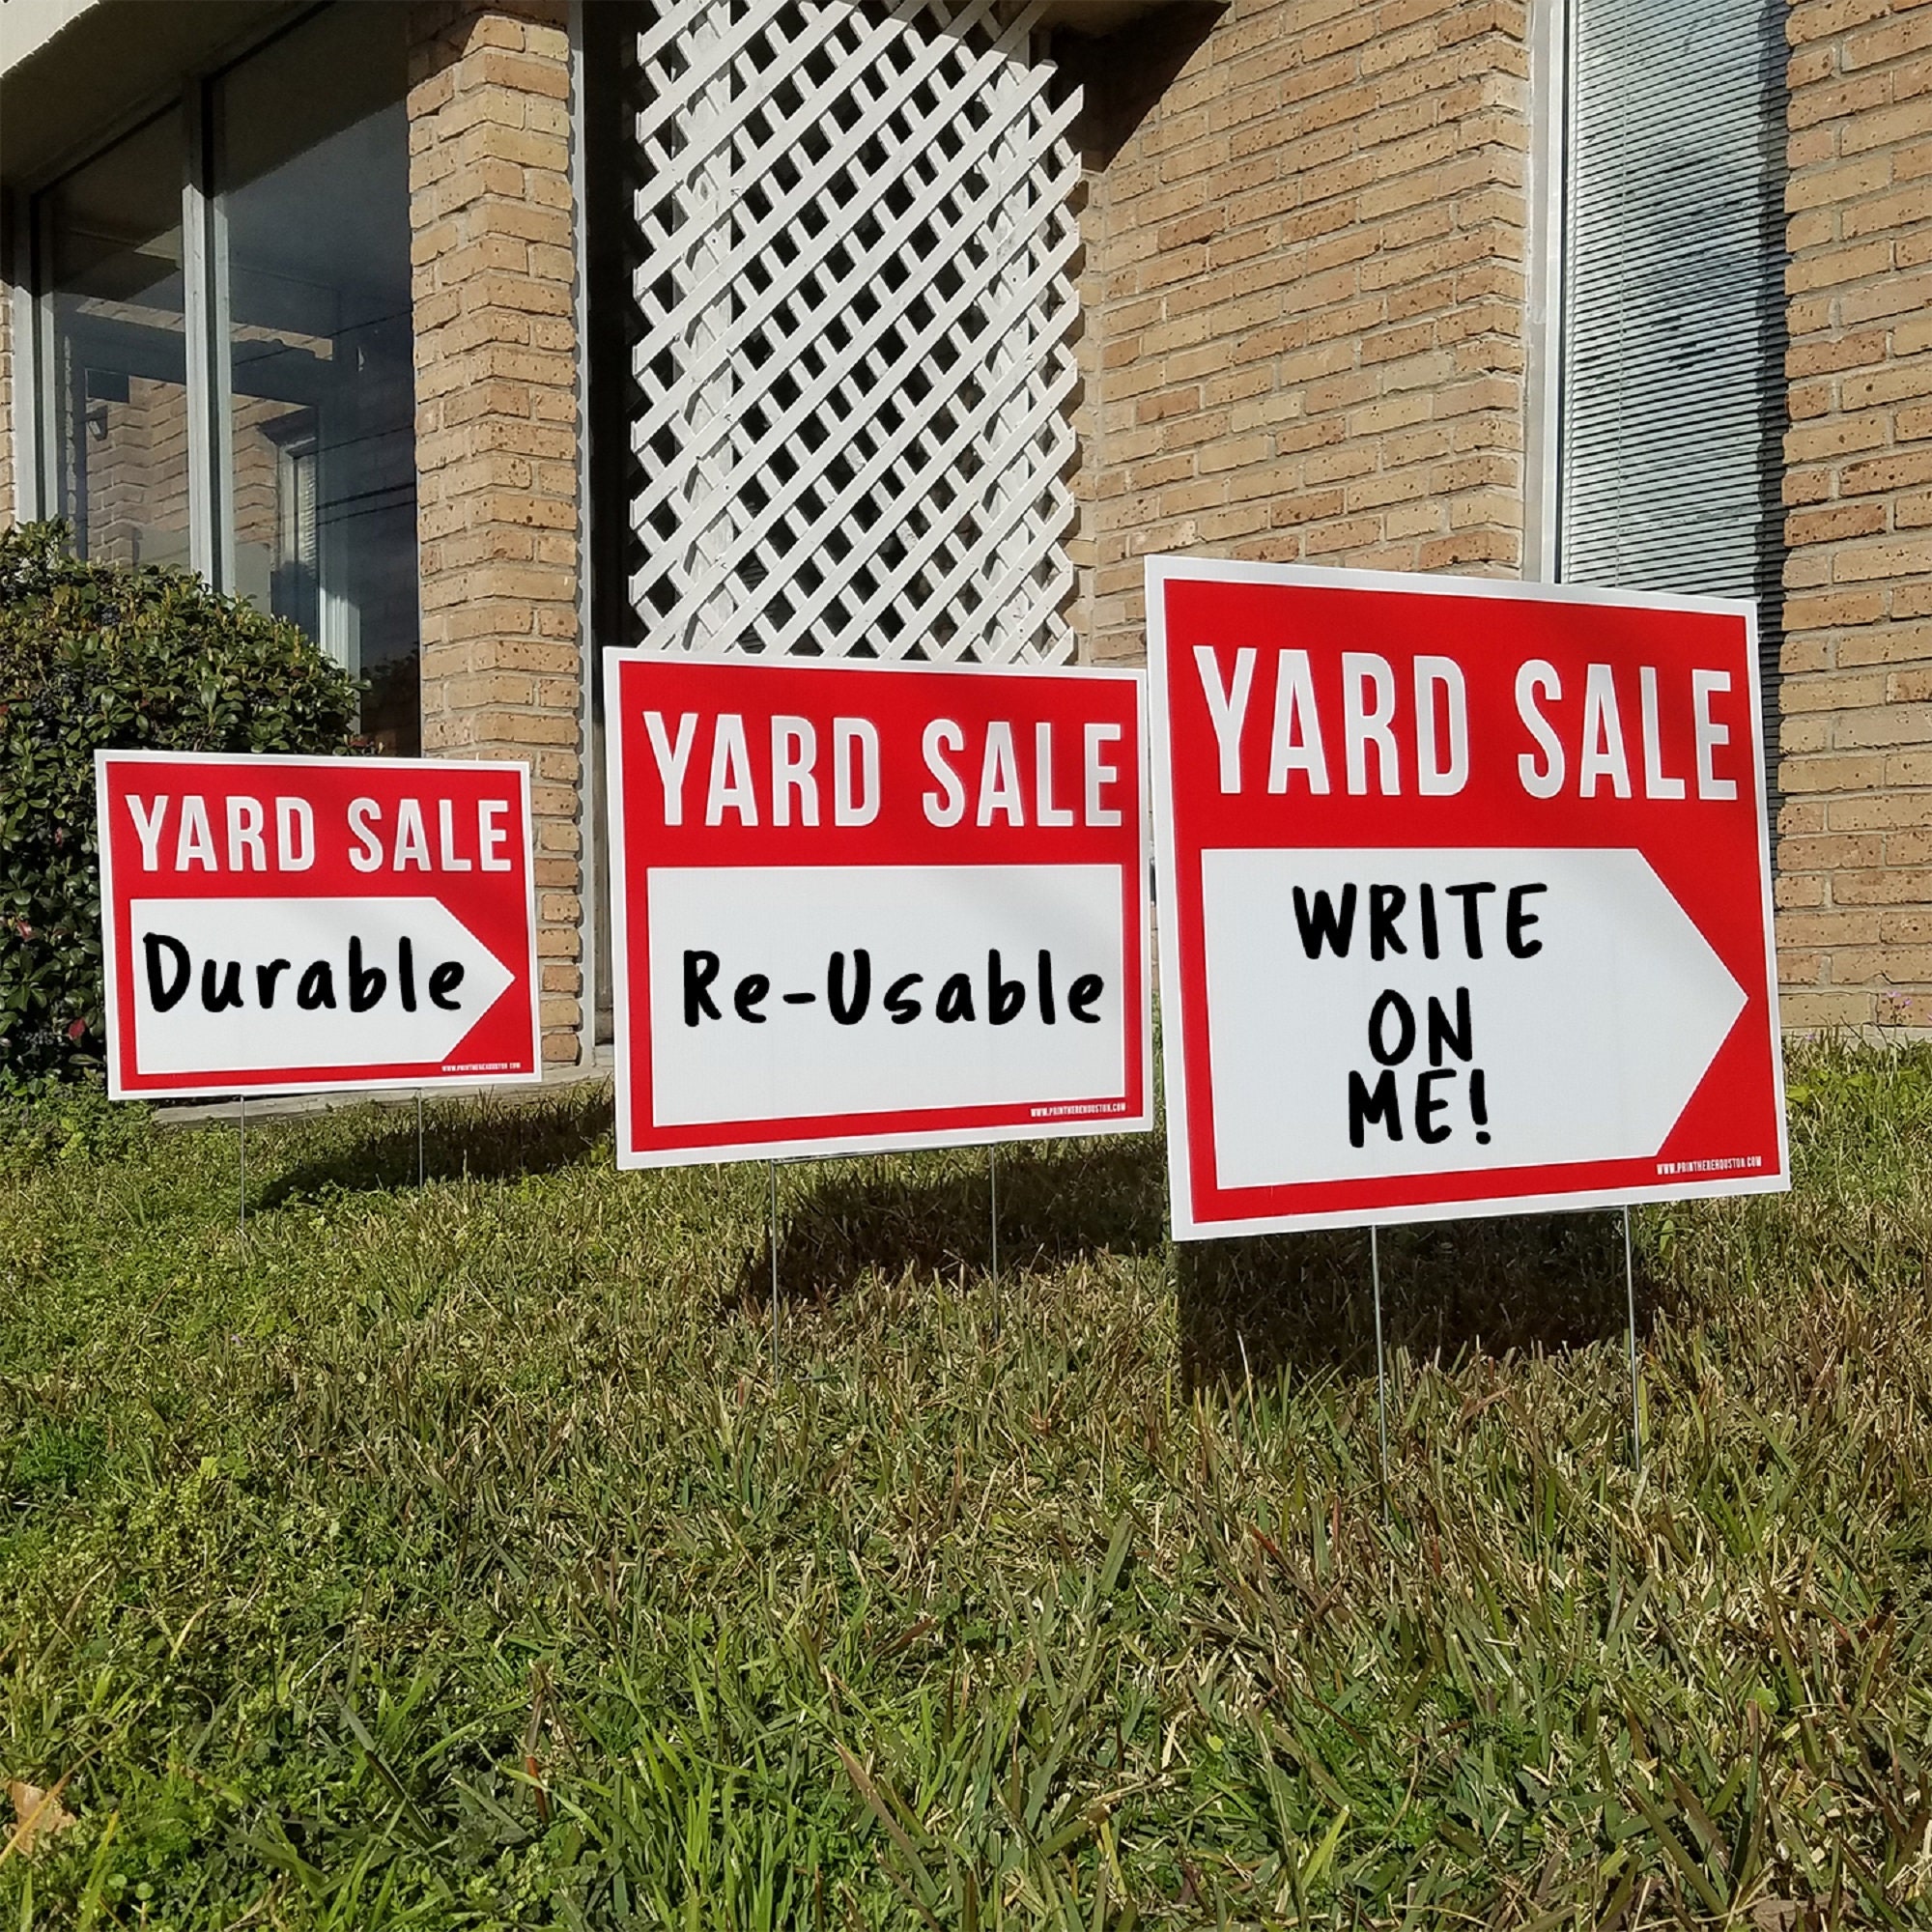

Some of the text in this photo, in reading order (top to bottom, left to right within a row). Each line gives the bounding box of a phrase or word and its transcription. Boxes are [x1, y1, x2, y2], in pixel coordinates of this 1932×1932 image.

[1192, 644, 1738, 801] YARD SALE
[642, 710, 1122, 828] YARD SALE
[125, 794, 512, 873] YARD SALE
[1293, 881, 1548, 960] WRITE
[142, 931, 465, 1013] Durable
[682, 949, 1105, 1028] Re-Usable
[1368, 986, 1473, 1067] ON
[1348, 1067, 1492, 1149] ME!
